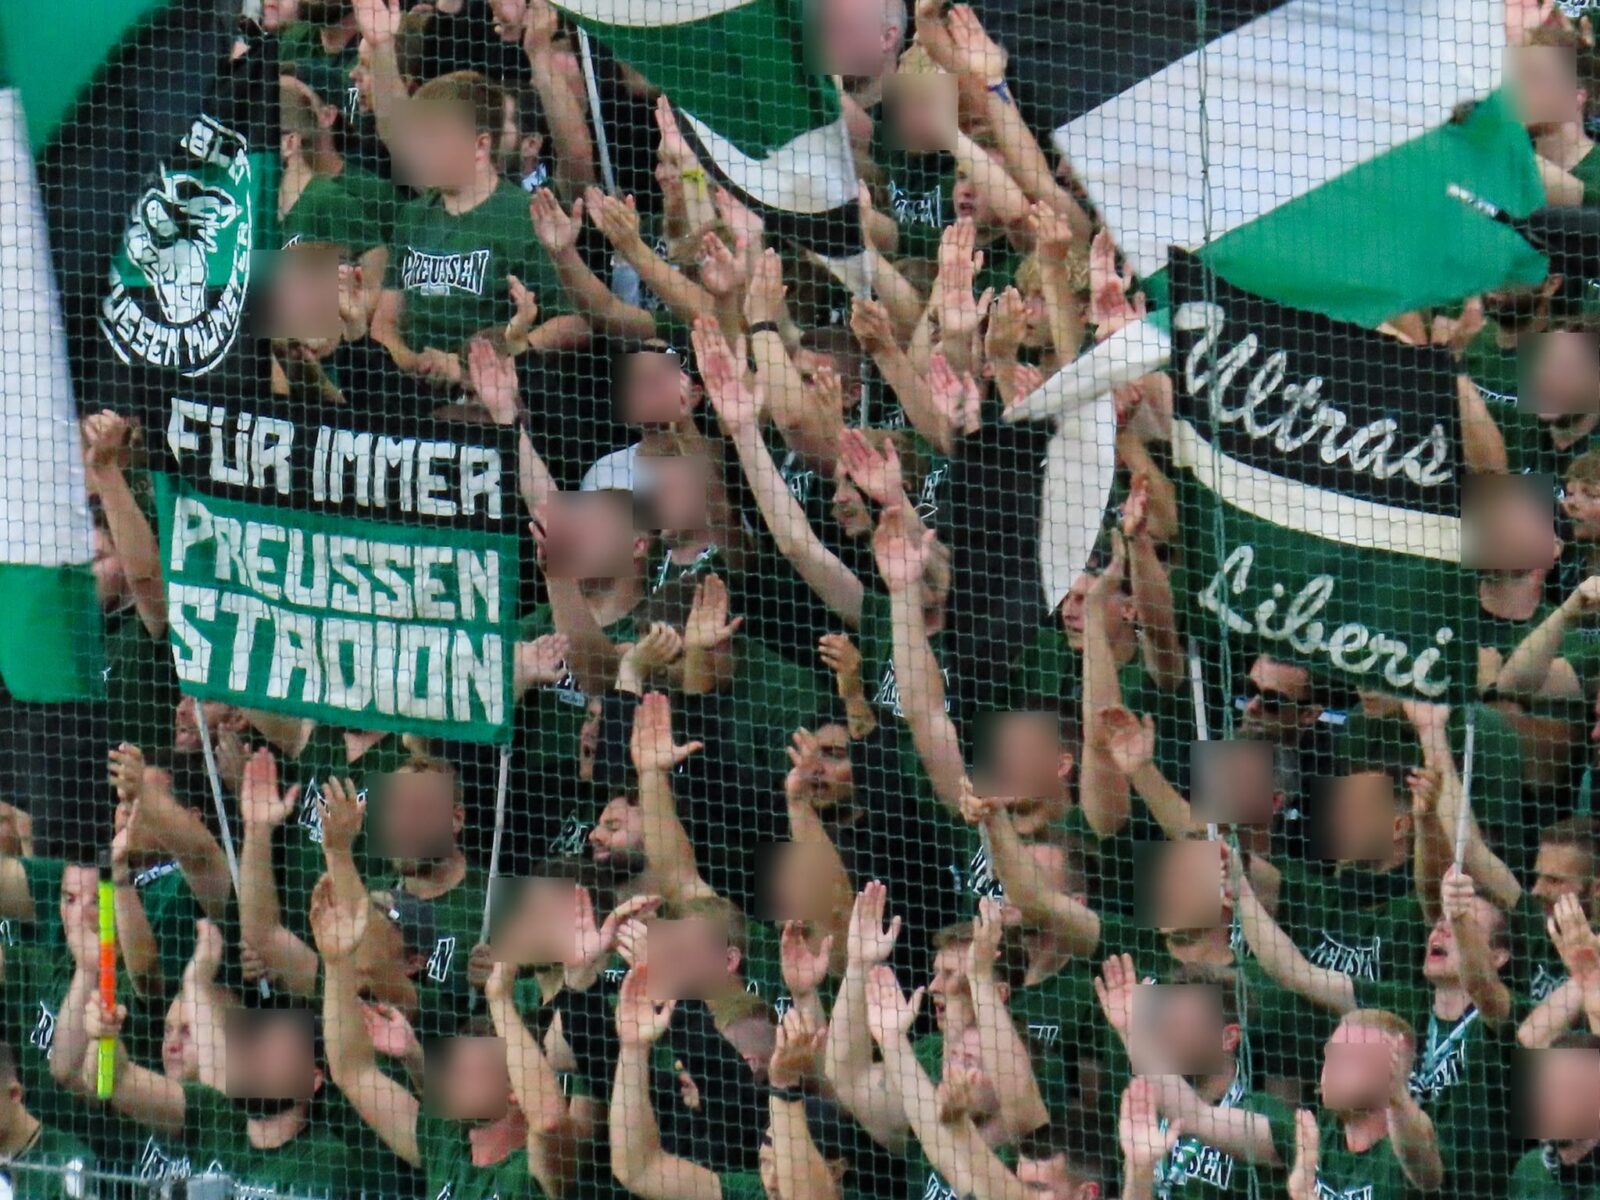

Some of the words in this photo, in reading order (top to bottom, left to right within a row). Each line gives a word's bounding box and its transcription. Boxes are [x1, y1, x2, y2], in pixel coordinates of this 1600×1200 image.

[167, 398, 295, 494] FÜR
[314, 426, 501, 518] IMMER
[1174, 301, 1452, 487] Ultras
[170, 497, 500, 622] PREUSSEN
[1198, 545, 1453, 696] Liberi
[169, 583, 502, 725] STADION
